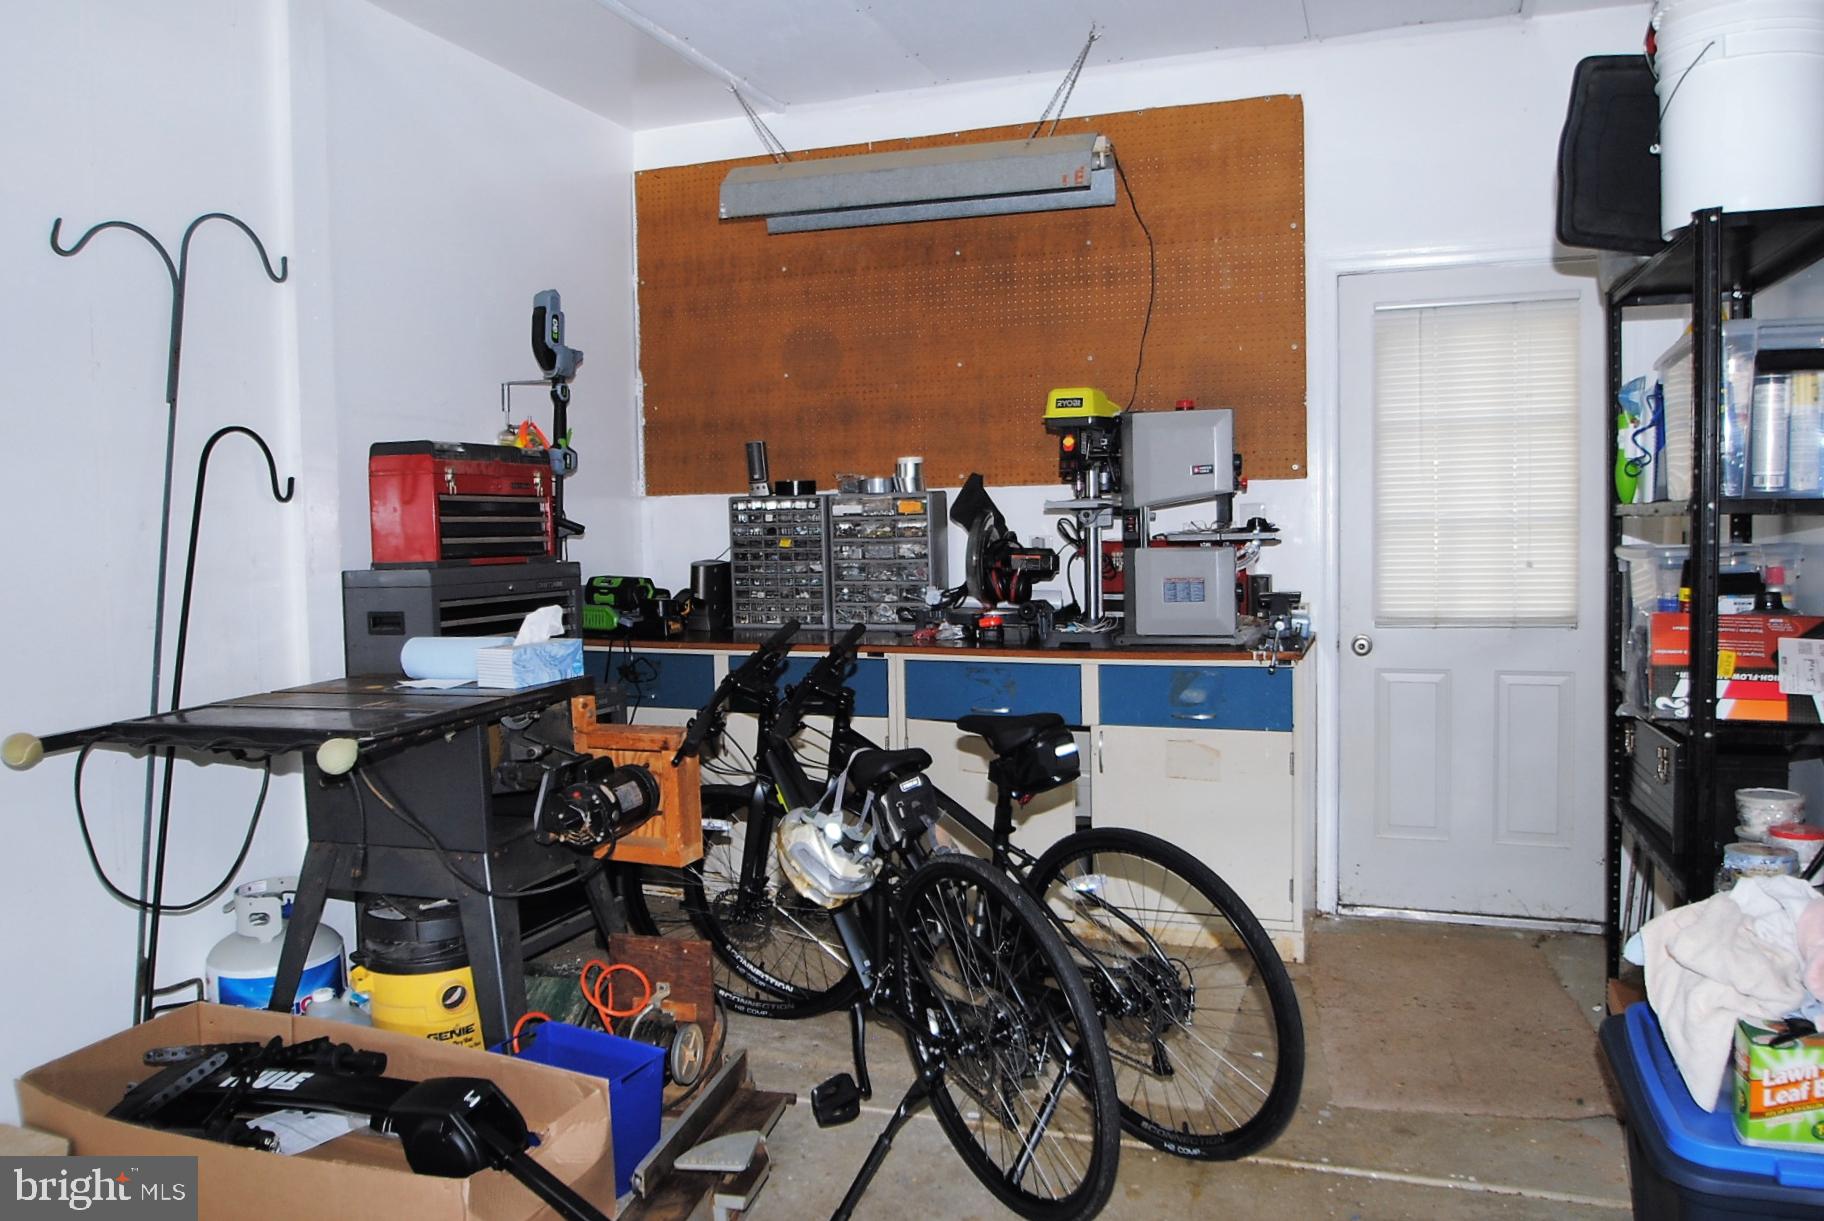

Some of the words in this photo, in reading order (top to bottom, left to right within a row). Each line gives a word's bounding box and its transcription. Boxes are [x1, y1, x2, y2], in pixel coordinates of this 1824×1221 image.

[1056, 399, 1081, 407] RYOBI
[746, 1008, 768, 1016] COMP
[427, 1023, 476, 1041] GENIE
[1762, 1066, 1819, 1087] Lawn
[1763, 1080, 1812, 1107] Leaf
